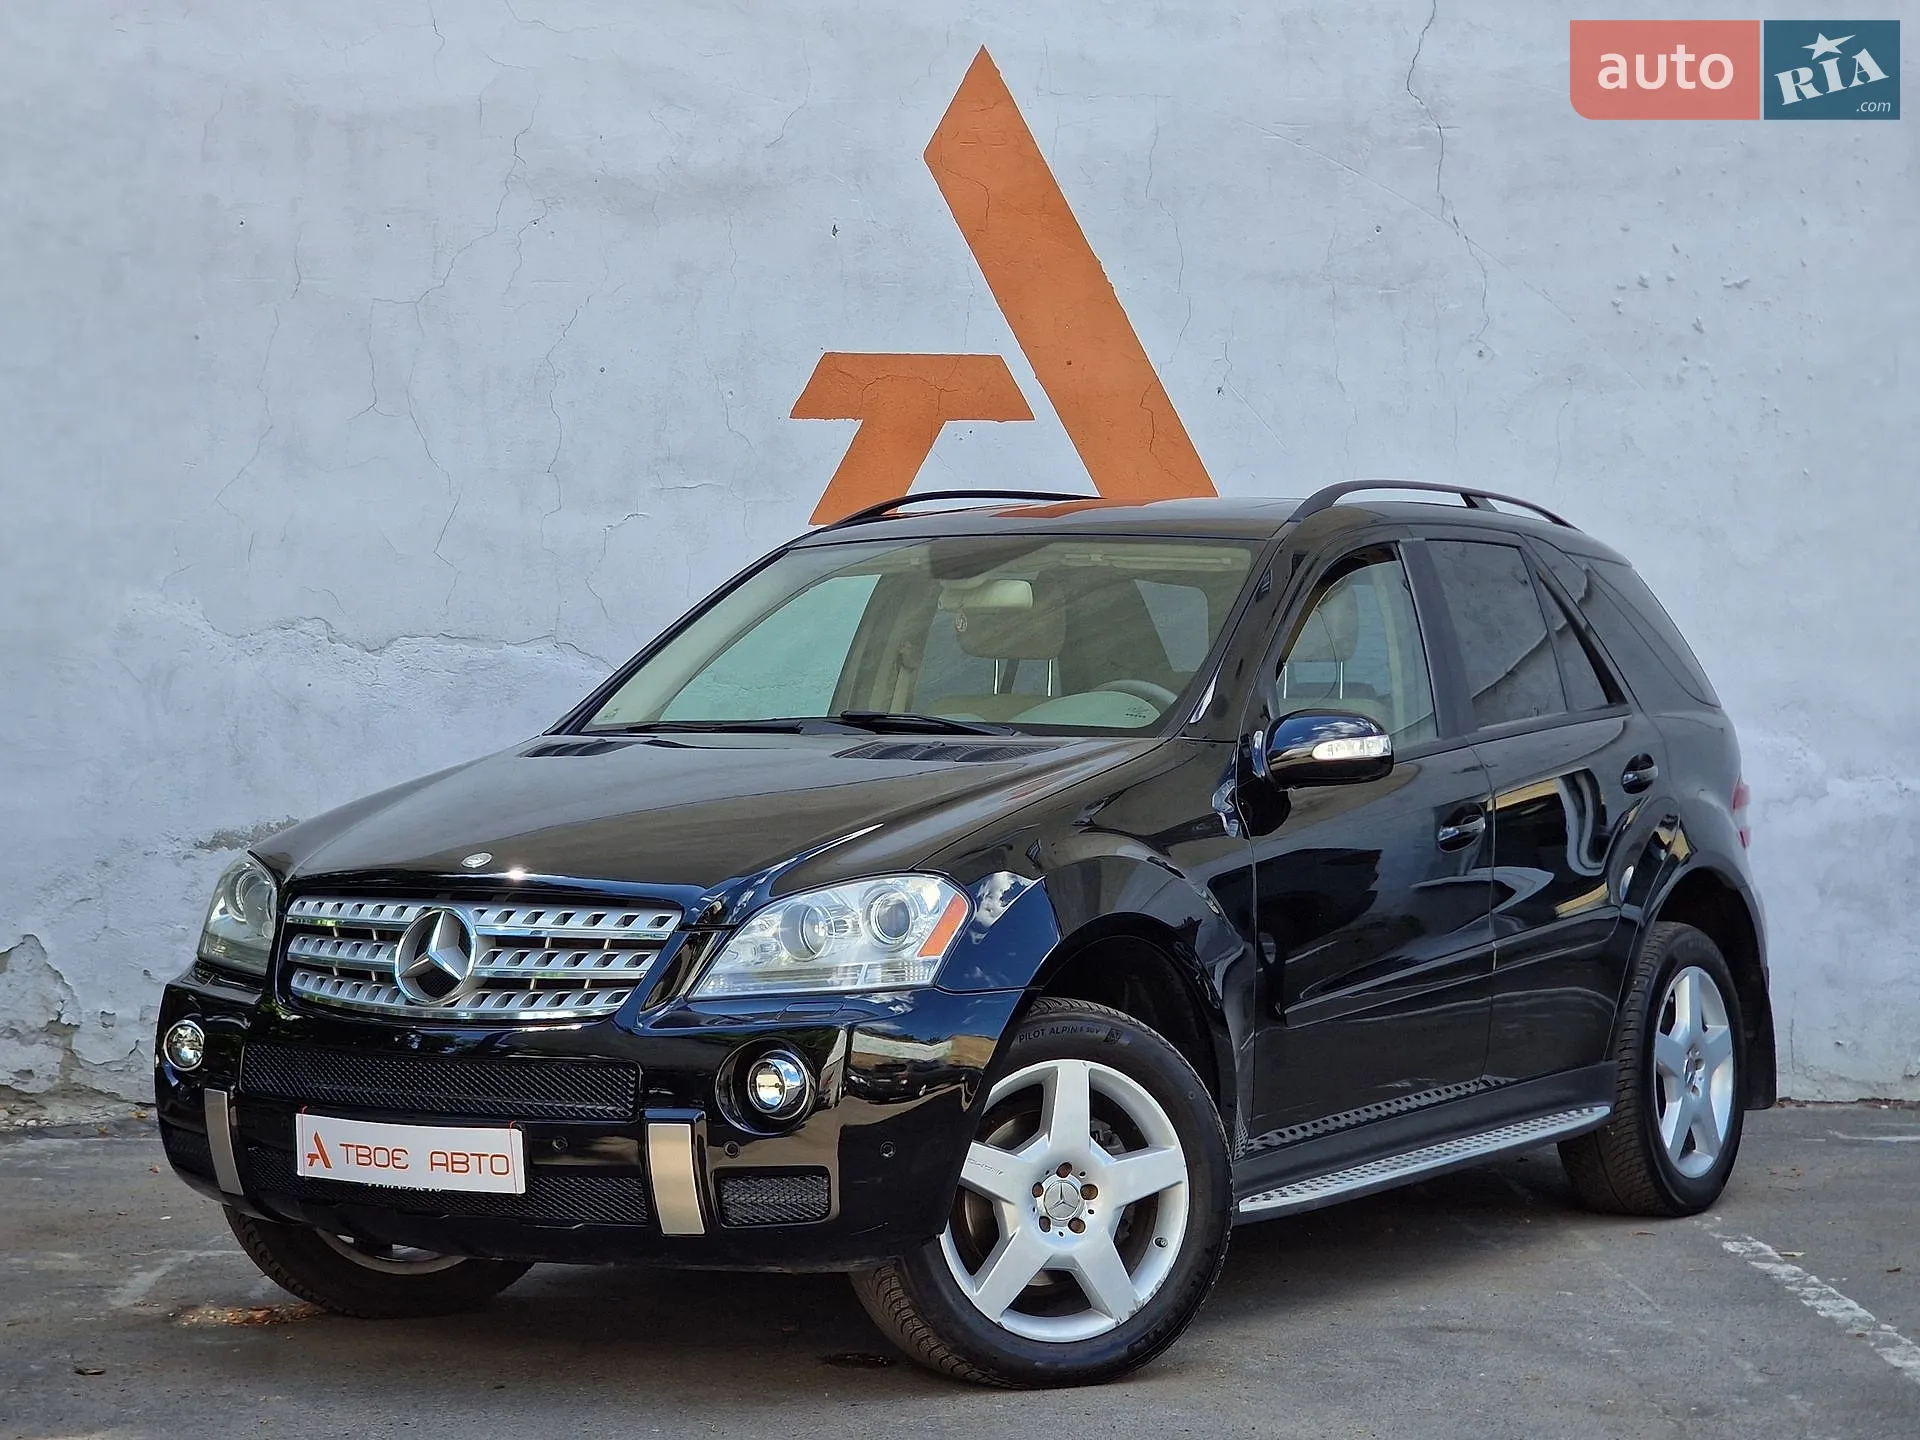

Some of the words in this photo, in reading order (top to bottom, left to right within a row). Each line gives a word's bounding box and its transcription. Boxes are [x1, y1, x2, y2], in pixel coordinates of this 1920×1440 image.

[1018, 1028, 1046, 1043] PILOT
[1049, 1025, 1077, 1035] ALPIN
[339, 1142, 409, 1170] ТВОЄ
[429, 1151, 511, 1176] АВТО
